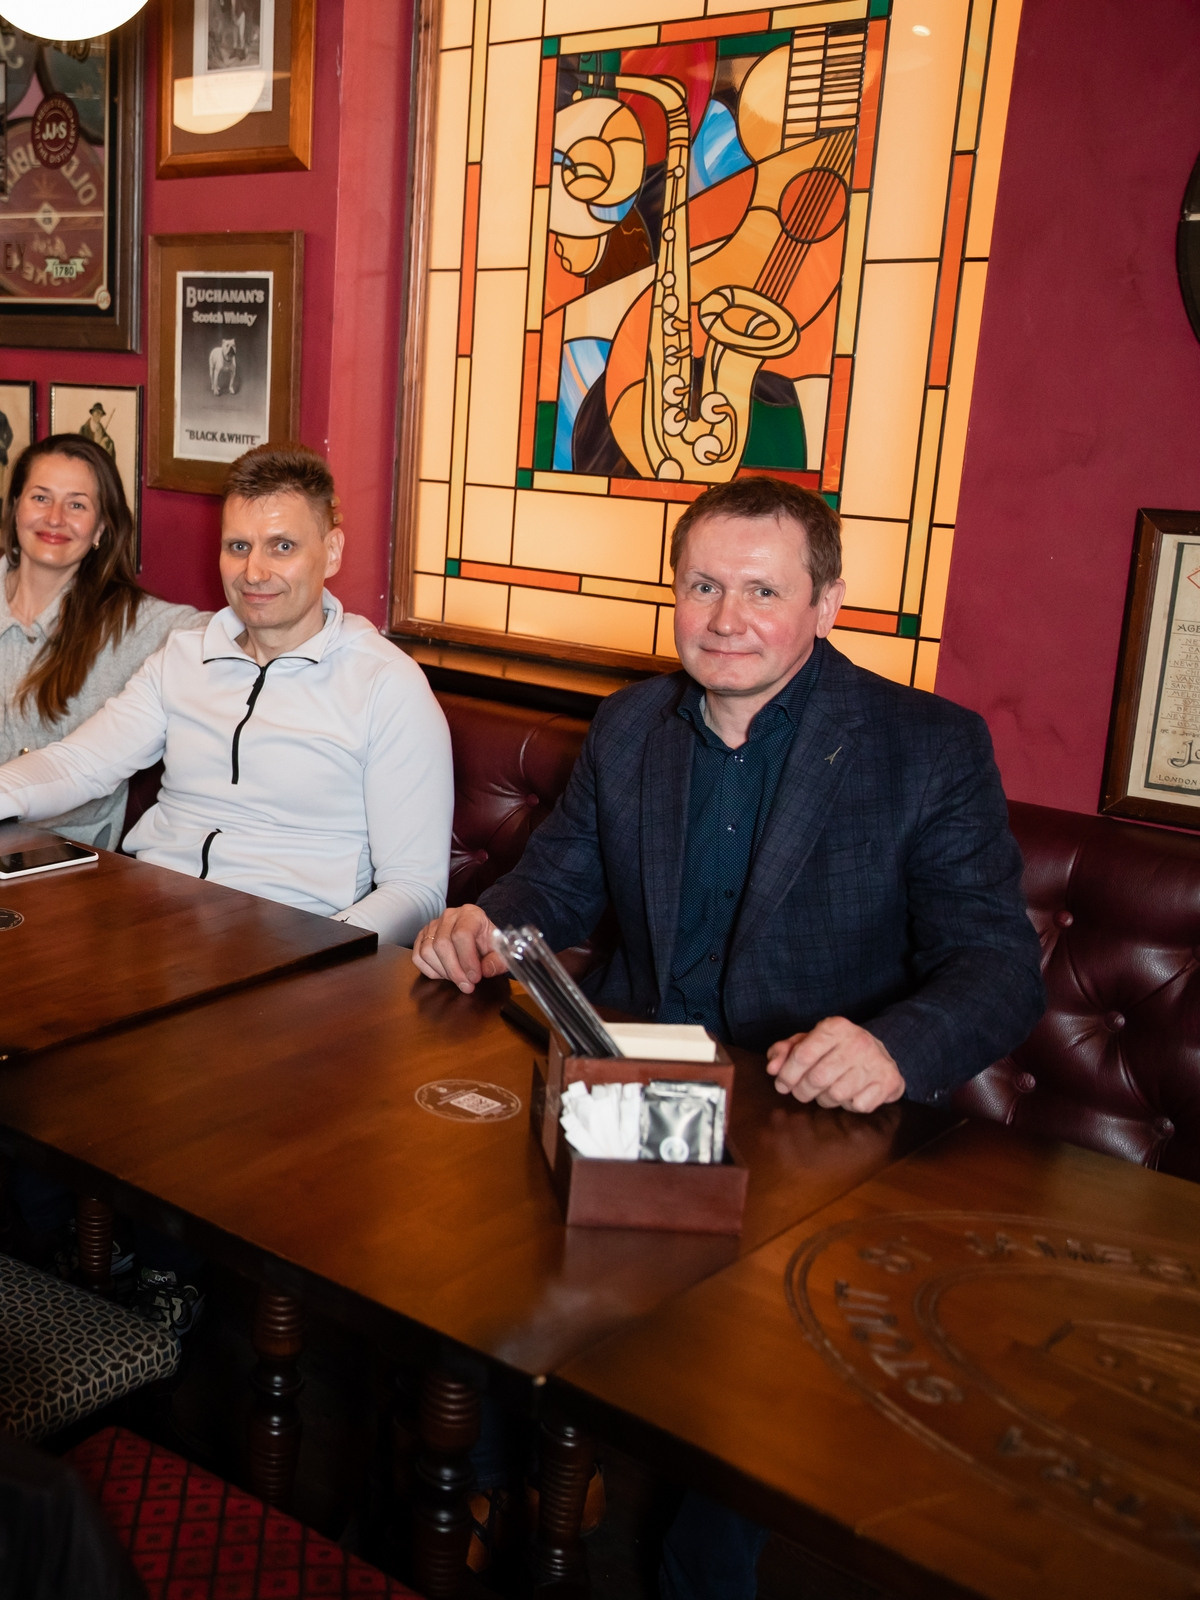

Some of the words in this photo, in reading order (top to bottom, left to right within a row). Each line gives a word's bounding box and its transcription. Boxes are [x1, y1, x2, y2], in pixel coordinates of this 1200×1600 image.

[54, 264, 75, 278] 1780
[185, 286, 265, 308] BUCHANAN'S
[192, 310, 223, 323] Scotch
[223, 311, 257, 327] Whisky
[1158, 775, 1198, 786] LONDON
